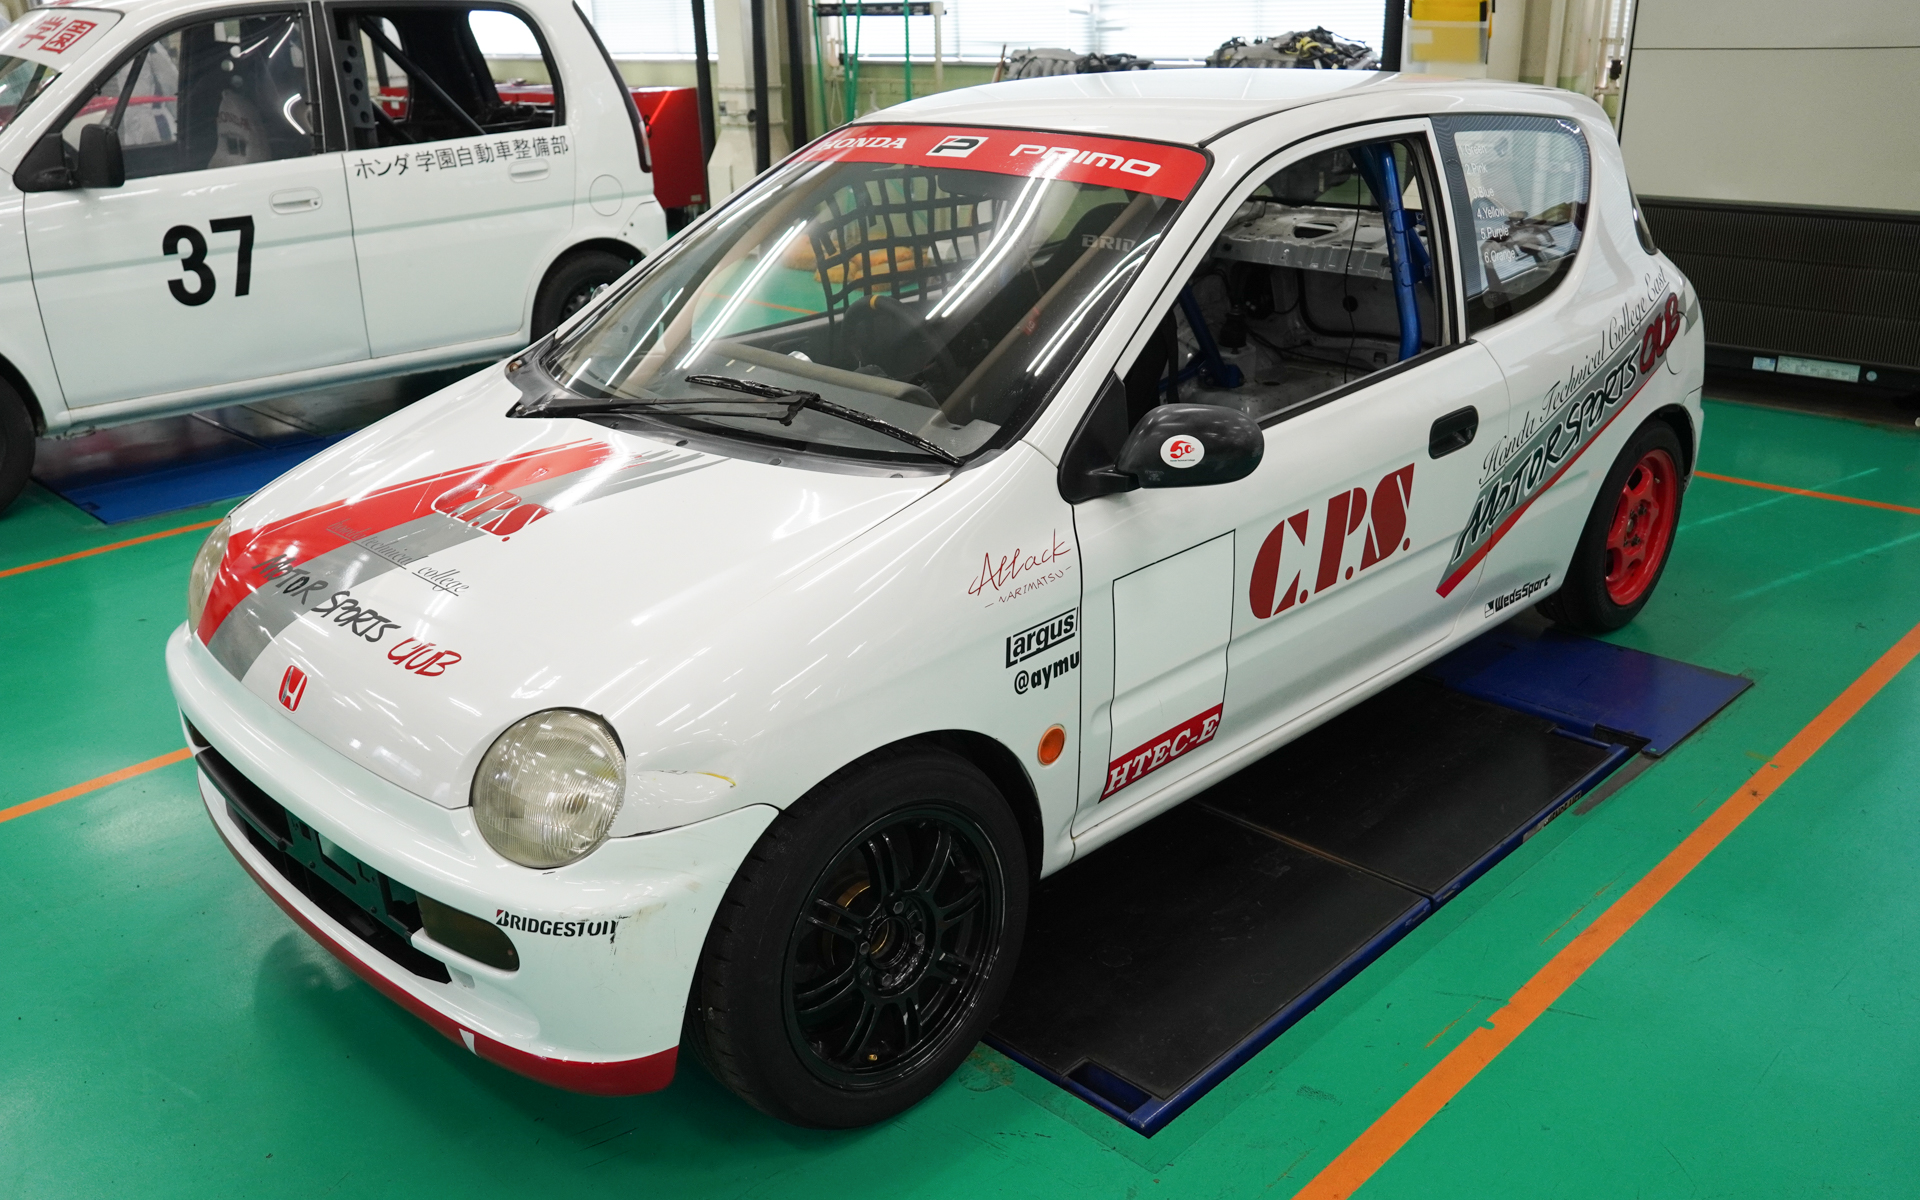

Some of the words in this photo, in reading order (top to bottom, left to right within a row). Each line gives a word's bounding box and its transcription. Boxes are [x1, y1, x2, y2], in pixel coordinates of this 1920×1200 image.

[817, 137, 907, 151] HONDA
[1009, 144, 1161, 177] PRIMO
[1477, 206, 1505, 220] 4.Yellow
[1480, 225, 1510, 240] 5.Purple
[162, 214, 255, 307] 37
[1484, 249, 1516, 263] 6.Orange
[417, 566, 470, 593] college
[1494, 573, 1551, 612] WedsSport
[1005, 611, 1076, 669] Largus
[1014, 650, 1080, 695] @aymu
[1103, 712, 1220, 796] HTEC-E
